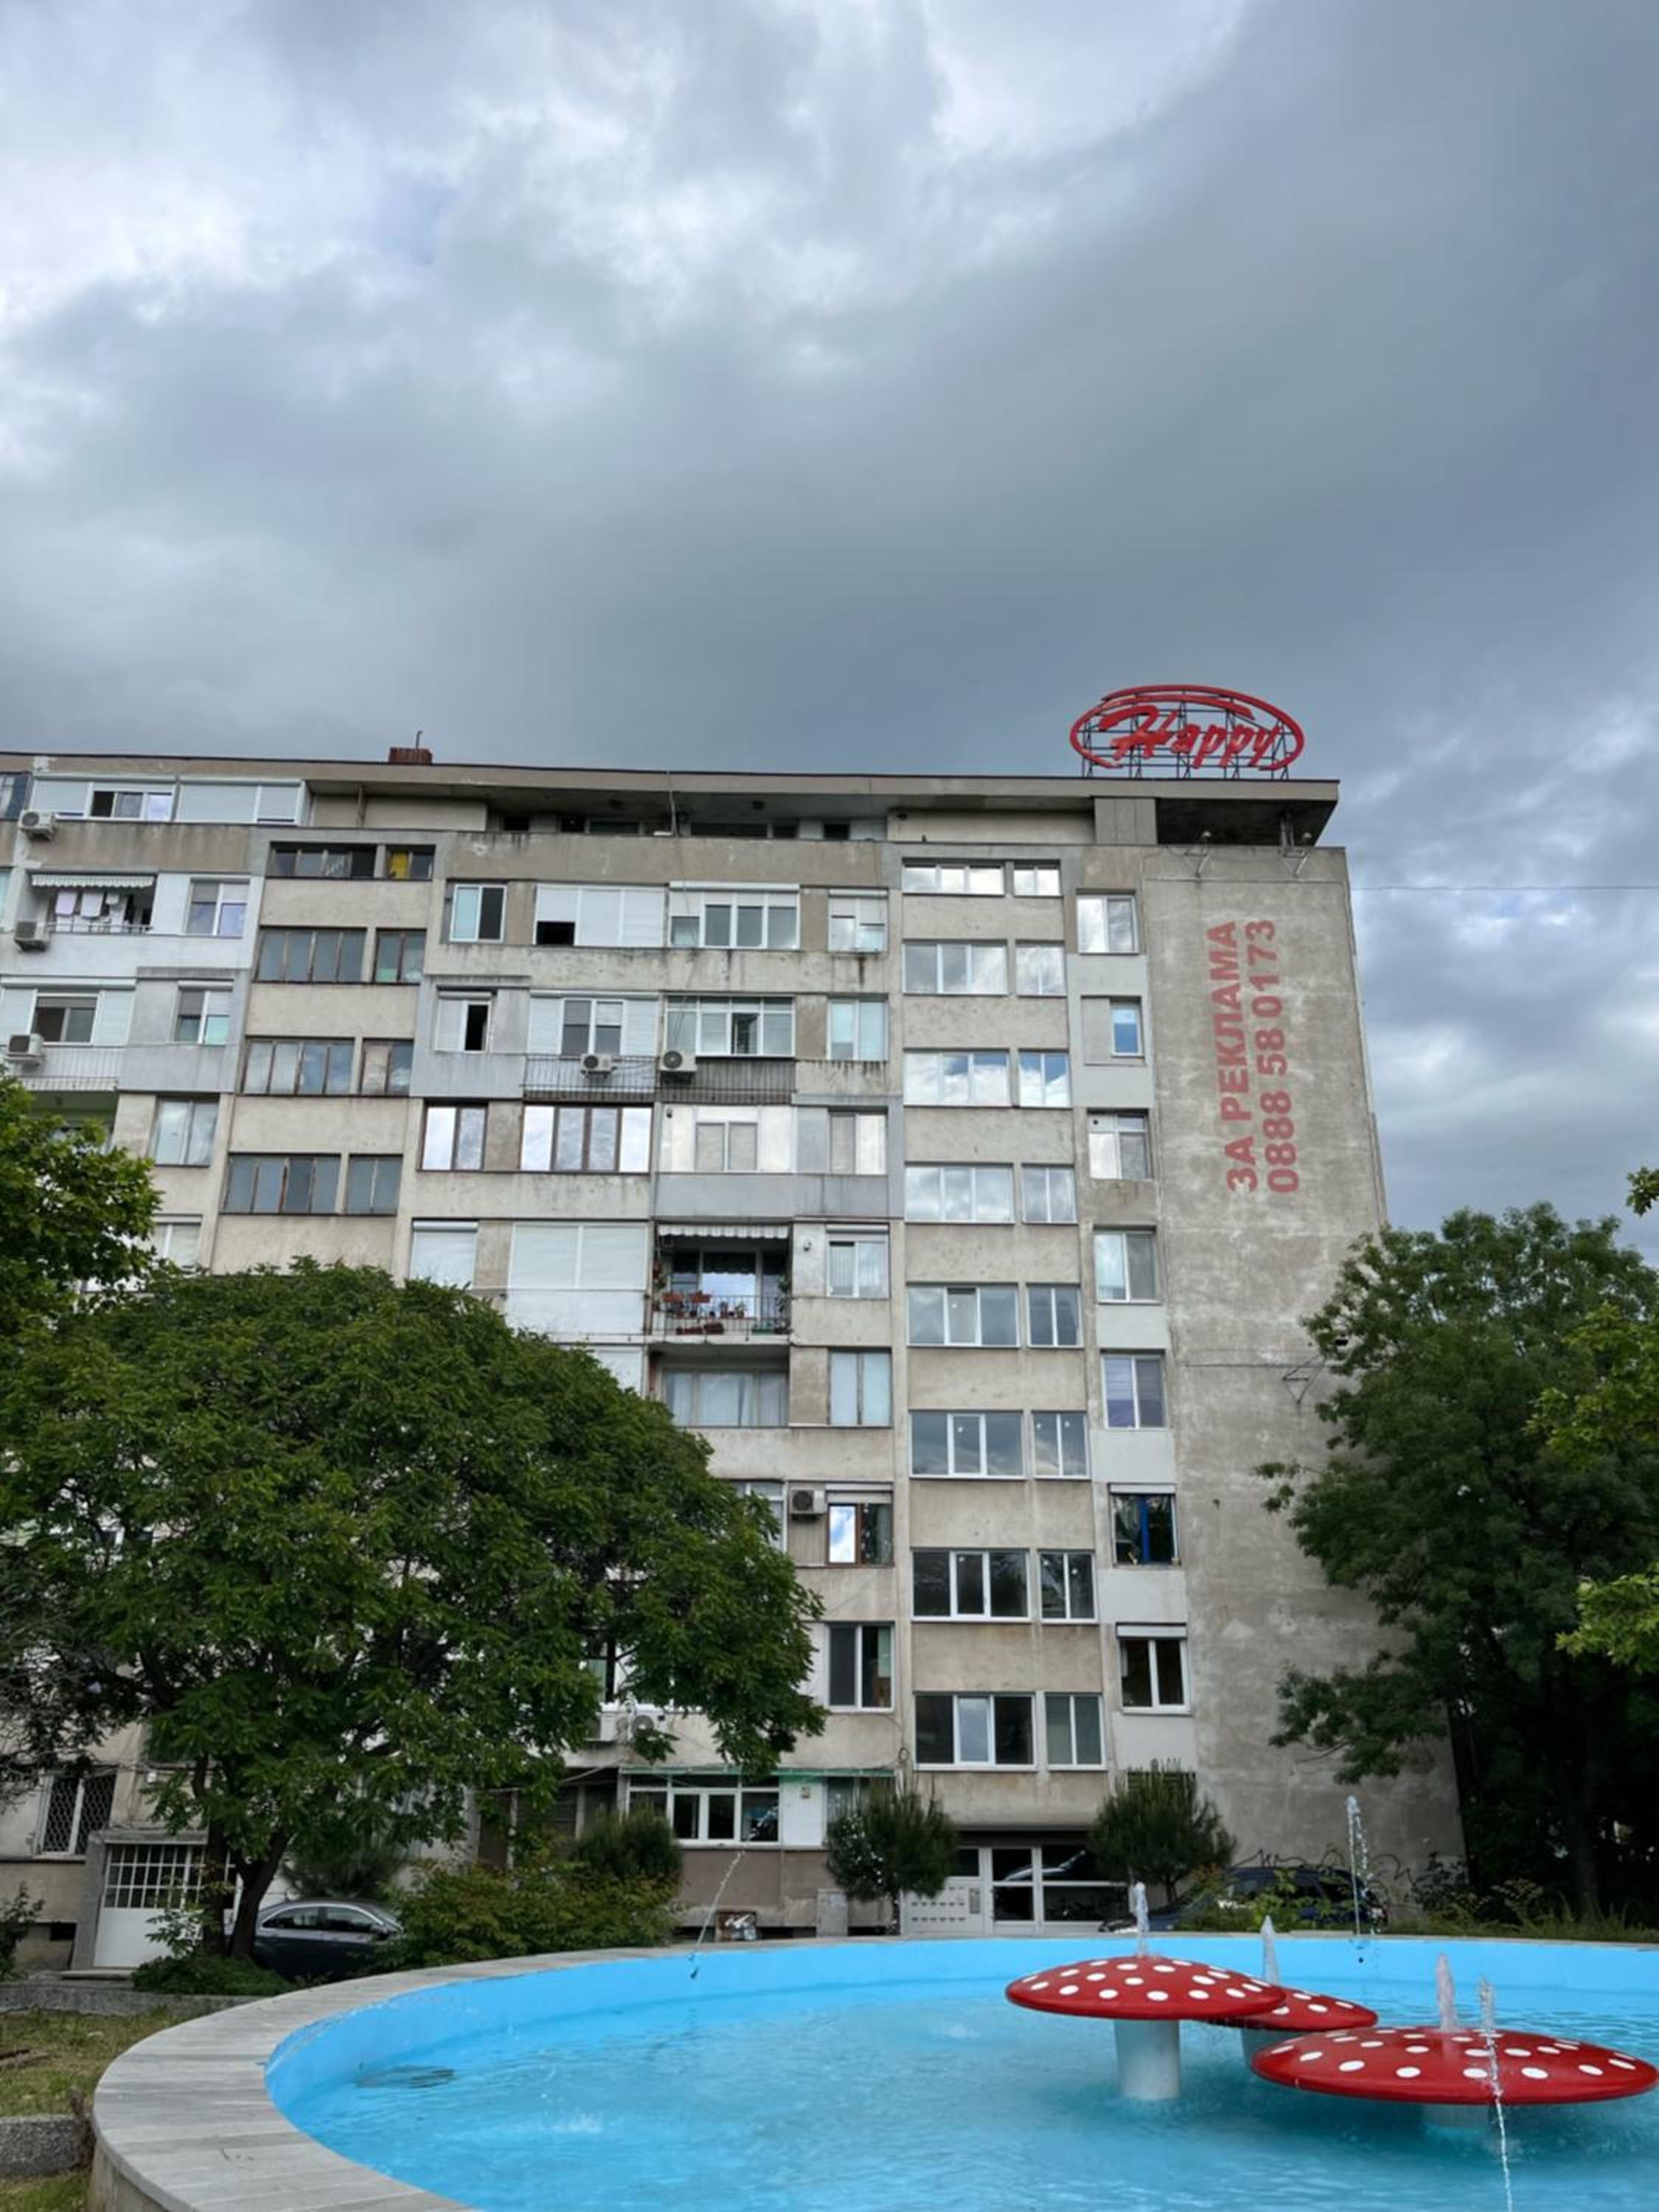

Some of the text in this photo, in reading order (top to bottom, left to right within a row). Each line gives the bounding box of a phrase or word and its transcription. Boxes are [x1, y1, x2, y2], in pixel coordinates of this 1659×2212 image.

[1099, 705, 1282, 768] Happy
[1206, 921, 1258, 1192] ЗА РЕКЛАМА
[1245, 921, 1300, 1194] 0888 58 0173
